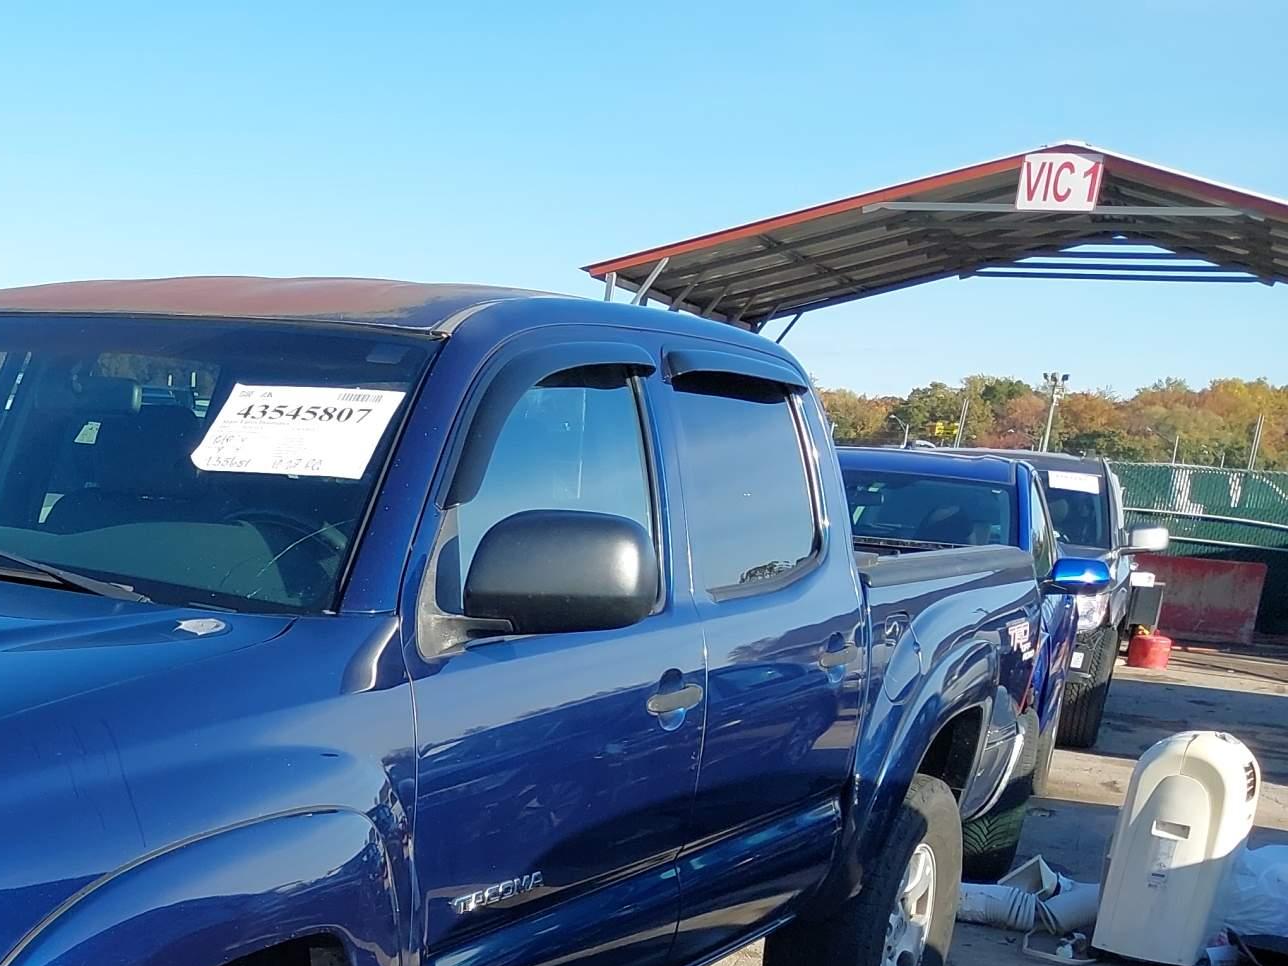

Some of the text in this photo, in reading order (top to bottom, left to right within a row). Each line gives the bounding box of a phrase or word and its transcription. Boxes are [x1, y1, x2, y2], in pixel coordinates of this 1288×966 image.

[1026, 161, 1100, 202] VIC 1
[236, 404, 373, 424] 43545807
[451, 871, 544, 914] TACOMA
